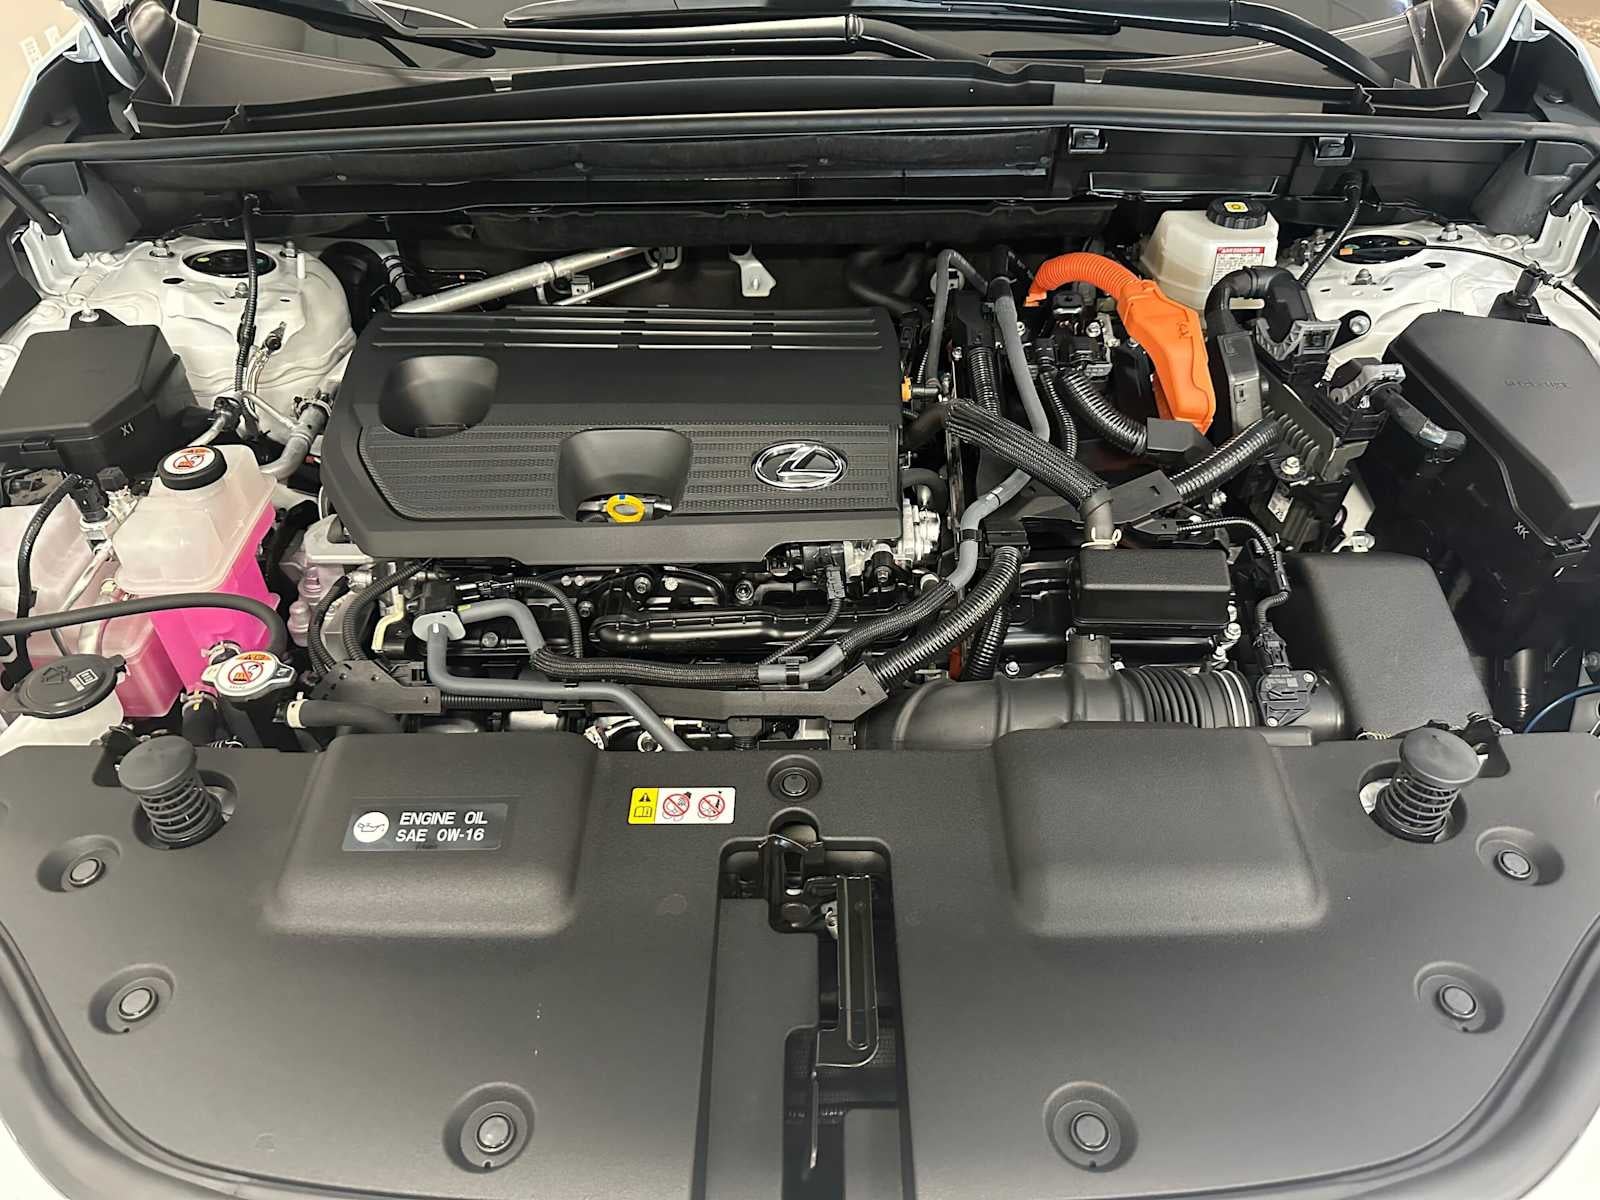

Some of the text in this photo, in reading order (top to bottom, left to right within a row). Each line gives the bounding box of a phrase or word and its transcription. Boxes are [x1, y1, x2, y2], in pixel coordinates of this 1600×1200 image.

[399, 811, 488, 825] ENGINE OIL
[395, 828, 485, 842] SAE 0W-16
